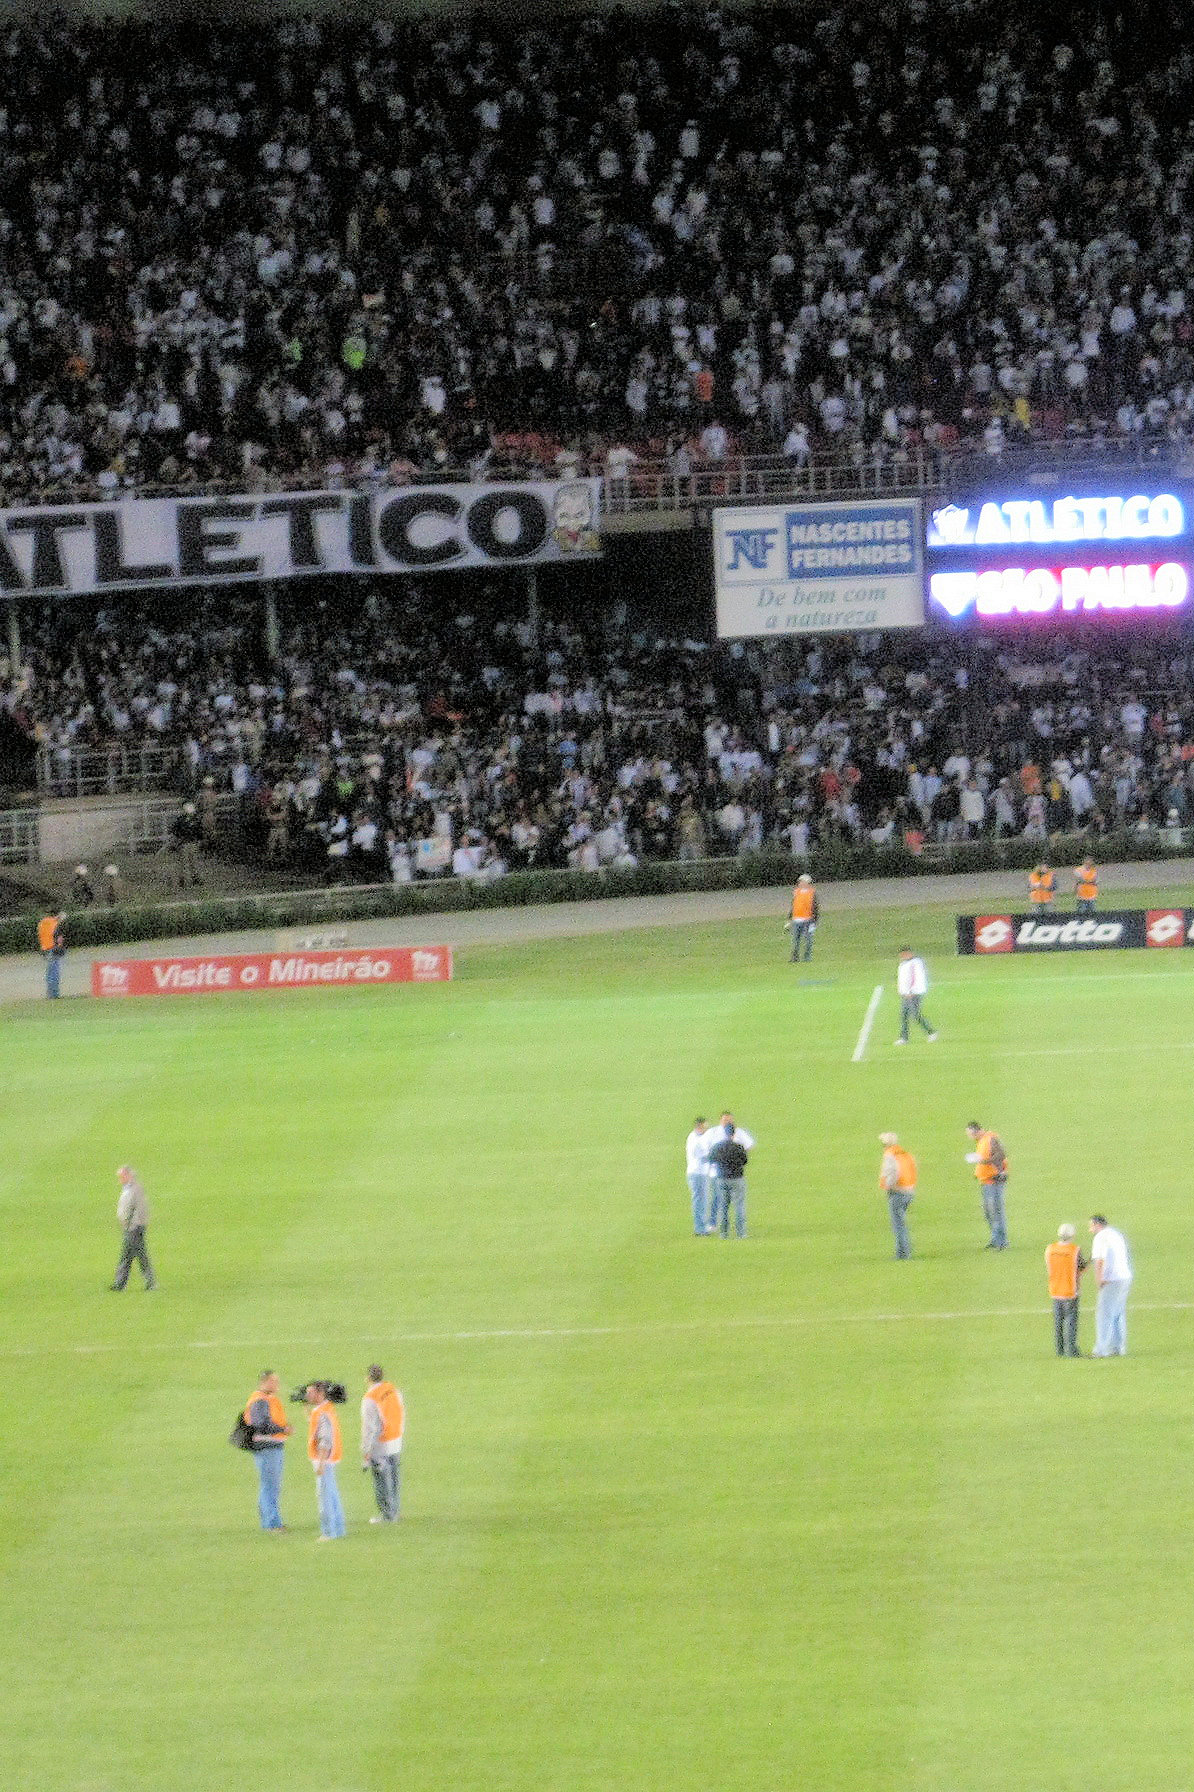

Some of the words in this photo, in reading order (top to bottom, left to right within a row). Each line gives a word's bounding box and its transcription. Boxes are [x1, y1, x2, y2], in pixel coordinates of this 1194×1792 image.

[792, 519, 911, 544] NASCENTES
[975, 494, 1184, 545] ATLÉTICO
[792, 544, 912, 568] FERNANDES
[757, 587, 786, 608] De
[793, 585, 836, 606] bem
[842, 586, 887, 602] com
[1062, 563, 1188, 611] PAULO
[765, 614, 777, 629] a
[786, 608, 878, 628] natureza
[1016, 919, 1123, 944] lotto
[152, 962, 231, 988] Visite
[240, 965, 259, 984] o
[269, 955, 392, 983] Mineirão
